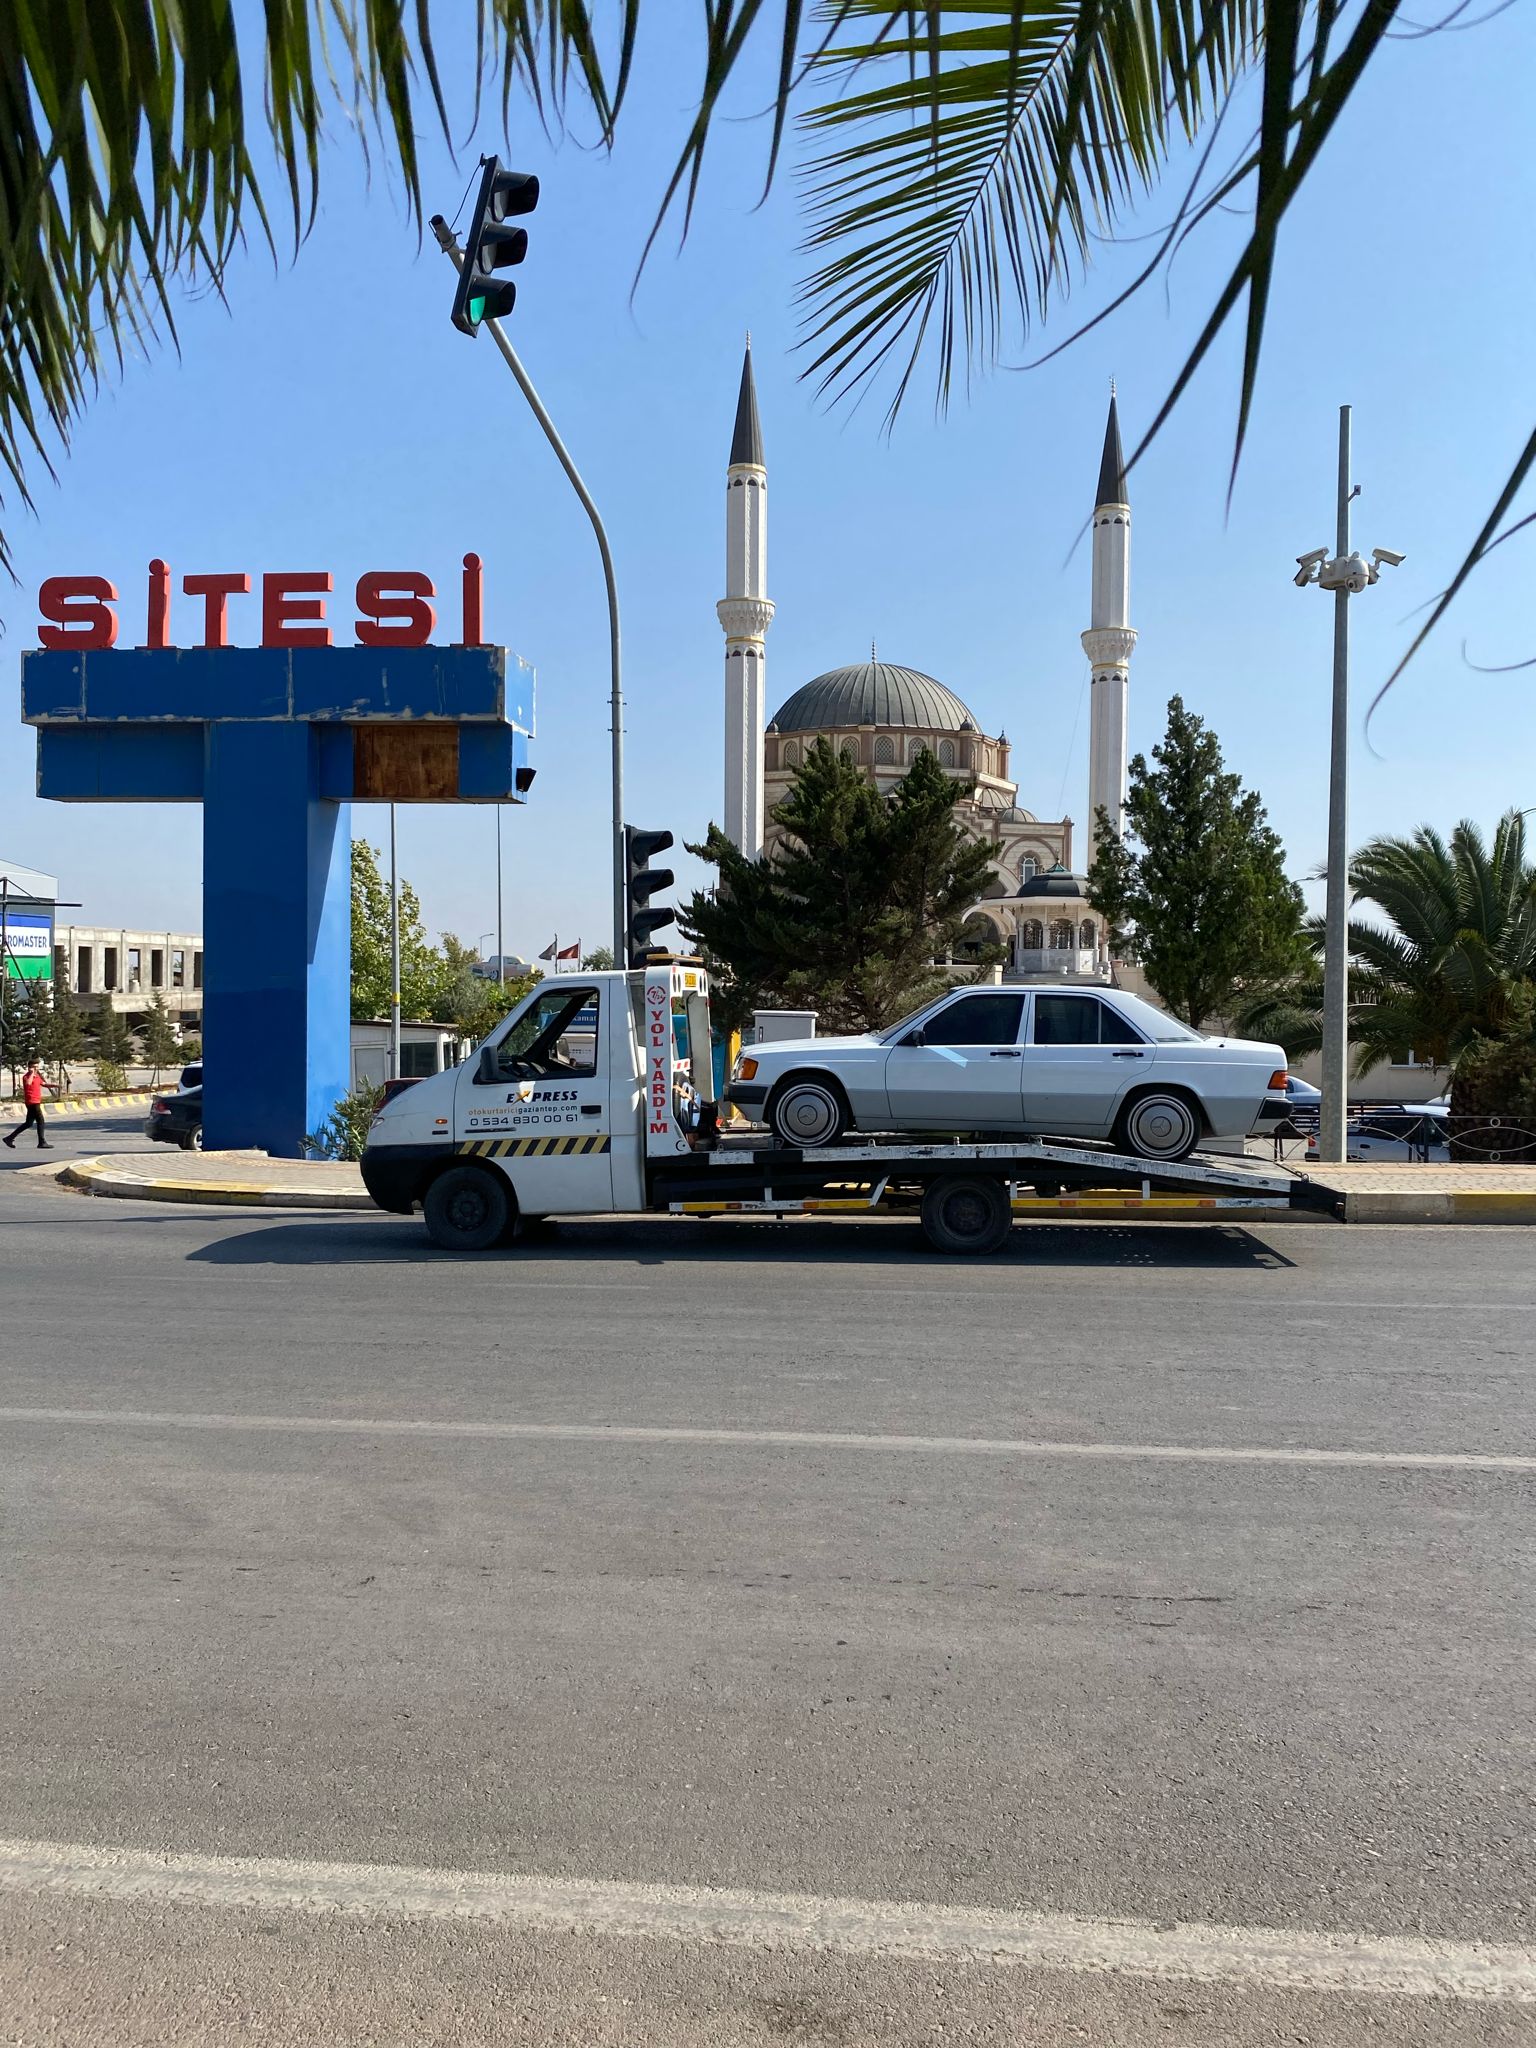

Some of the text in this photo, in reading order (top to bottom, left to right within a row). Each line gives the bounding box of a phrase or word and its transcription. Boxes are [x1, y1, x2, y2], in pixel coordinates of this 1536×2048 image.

[38, 553, 484, 650] SİTESİ
[649, 1010, 668, 1134] YOL YARDIM
[506, 1090, 578, 1105] EXPRESS
[468, 1105, 578, 1116] otokurtaricigaziantep.com
[470, 1114, 578, 1126] 0 534 830 00 61
